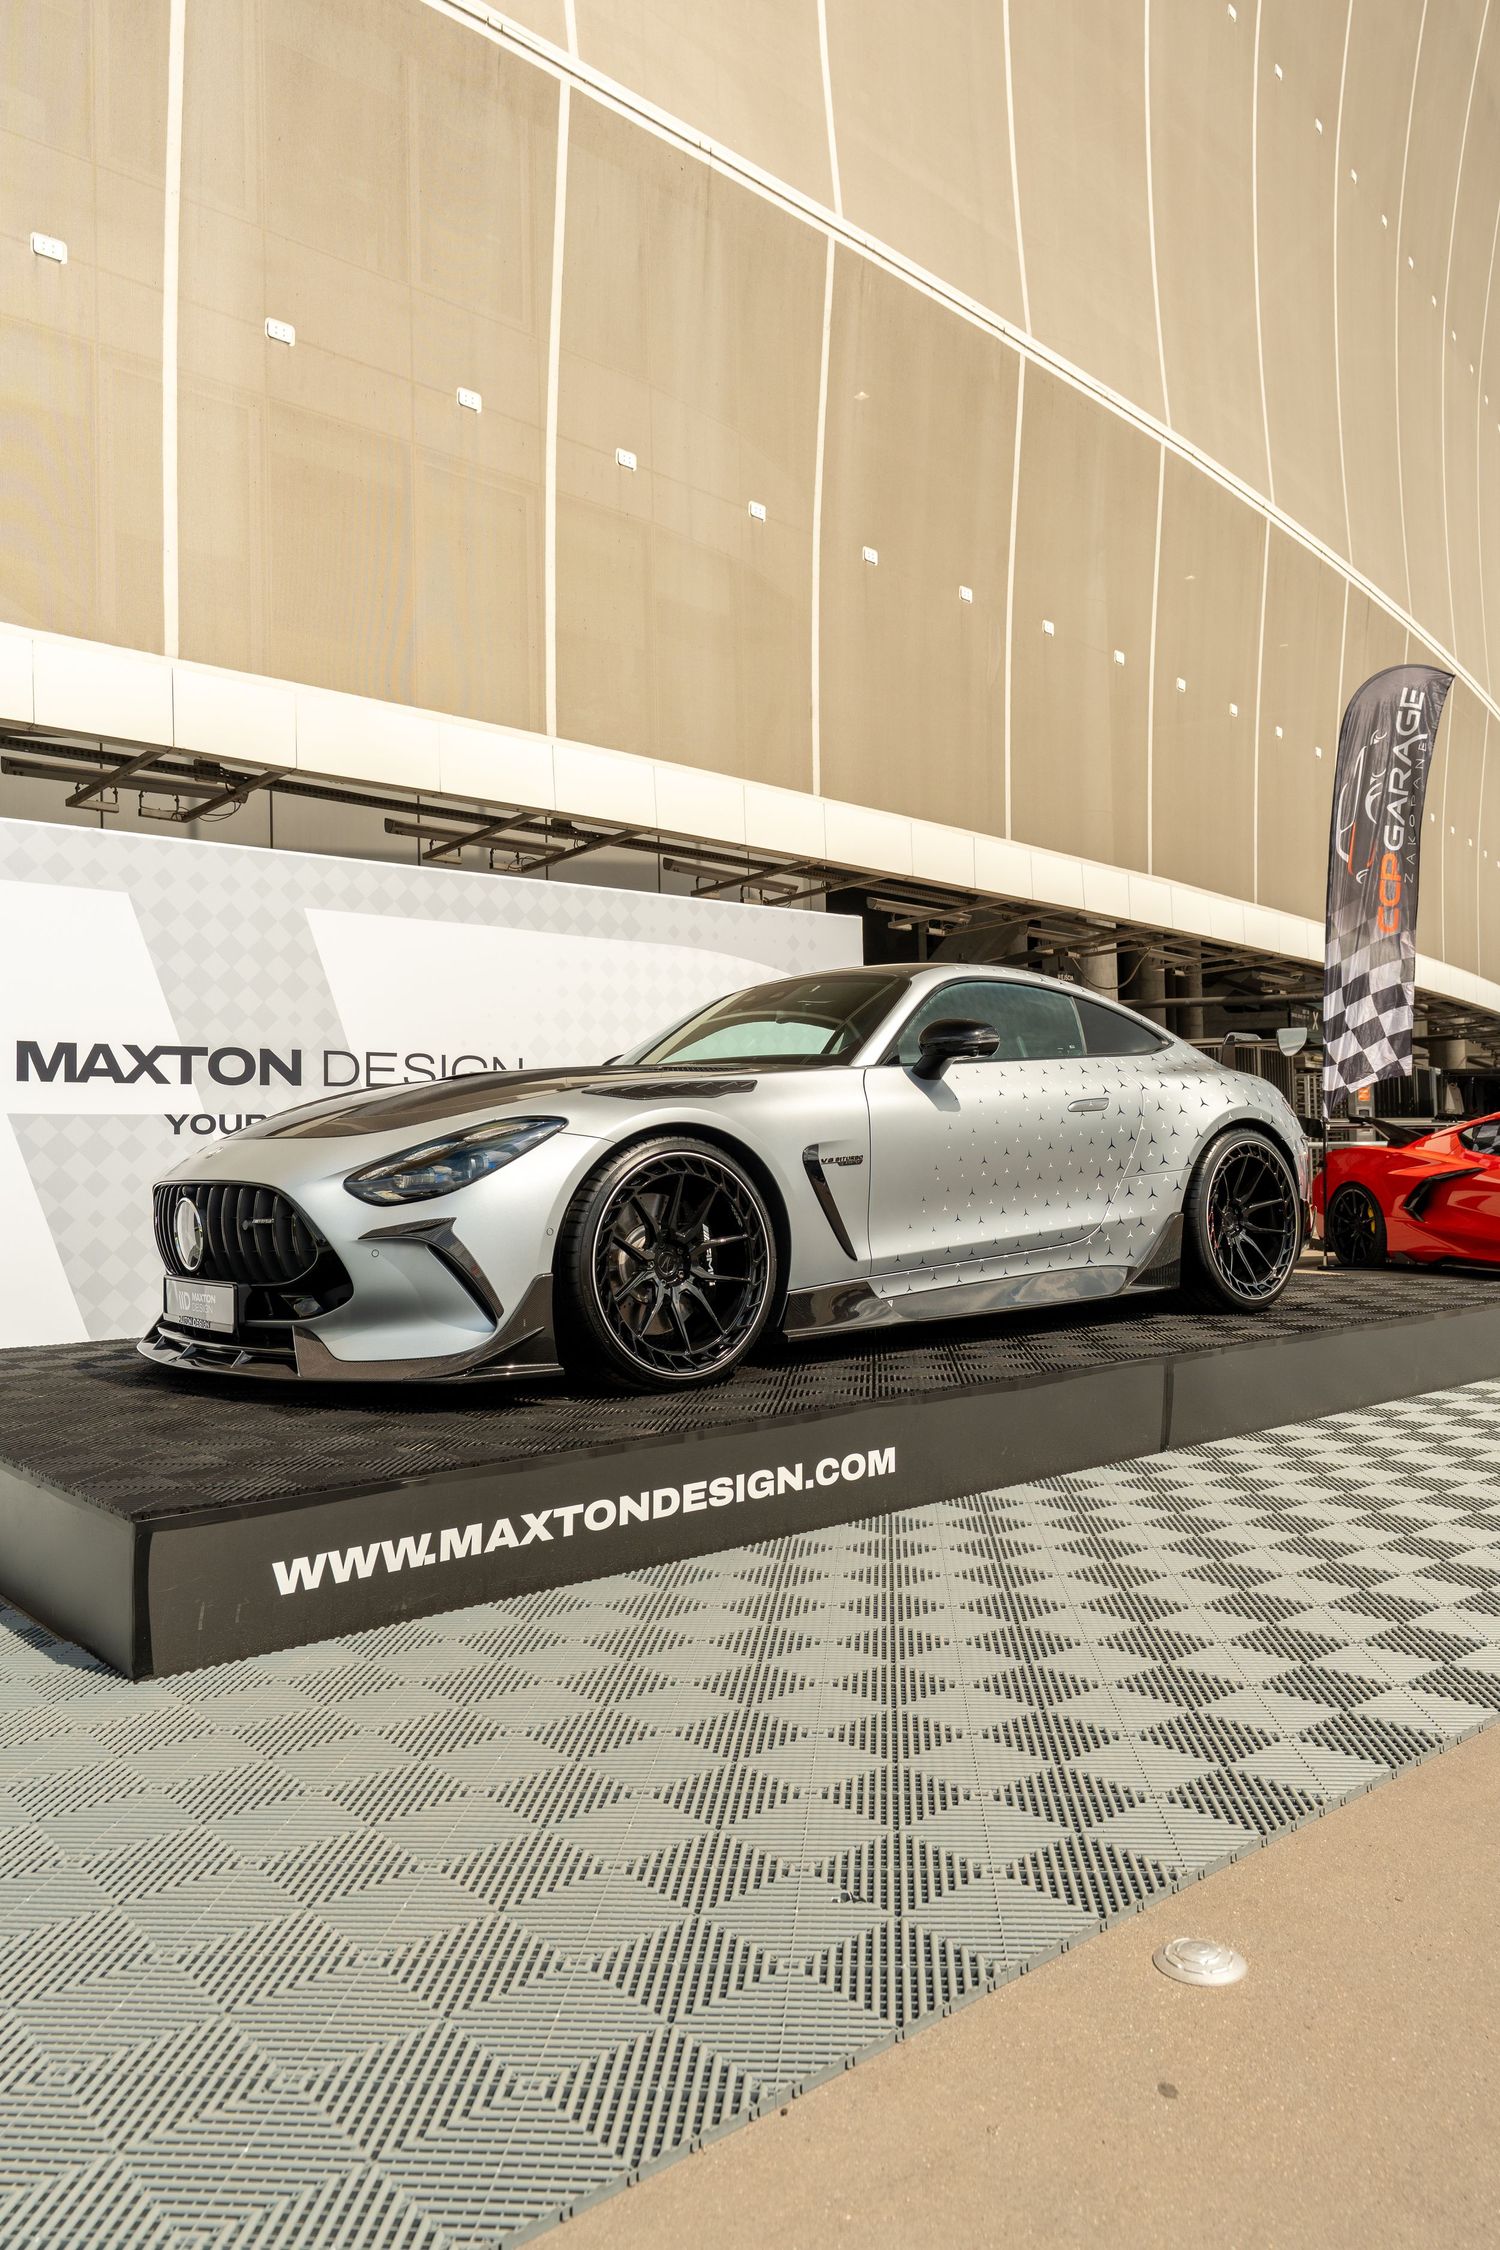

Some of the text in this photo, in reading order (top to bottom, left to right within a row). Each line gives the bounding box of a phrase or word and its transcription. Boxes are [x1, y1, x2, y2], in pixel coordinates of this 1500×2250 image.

[1404, 742, 1427, 884] ZAKOPANE
[16, 1040, 523, 1087] MAXTON DESI
[191, 1292, 216, 1304] MAXTON
[272, 1447, 897, 1596] WWW.MAXTONDESIGN.COM
